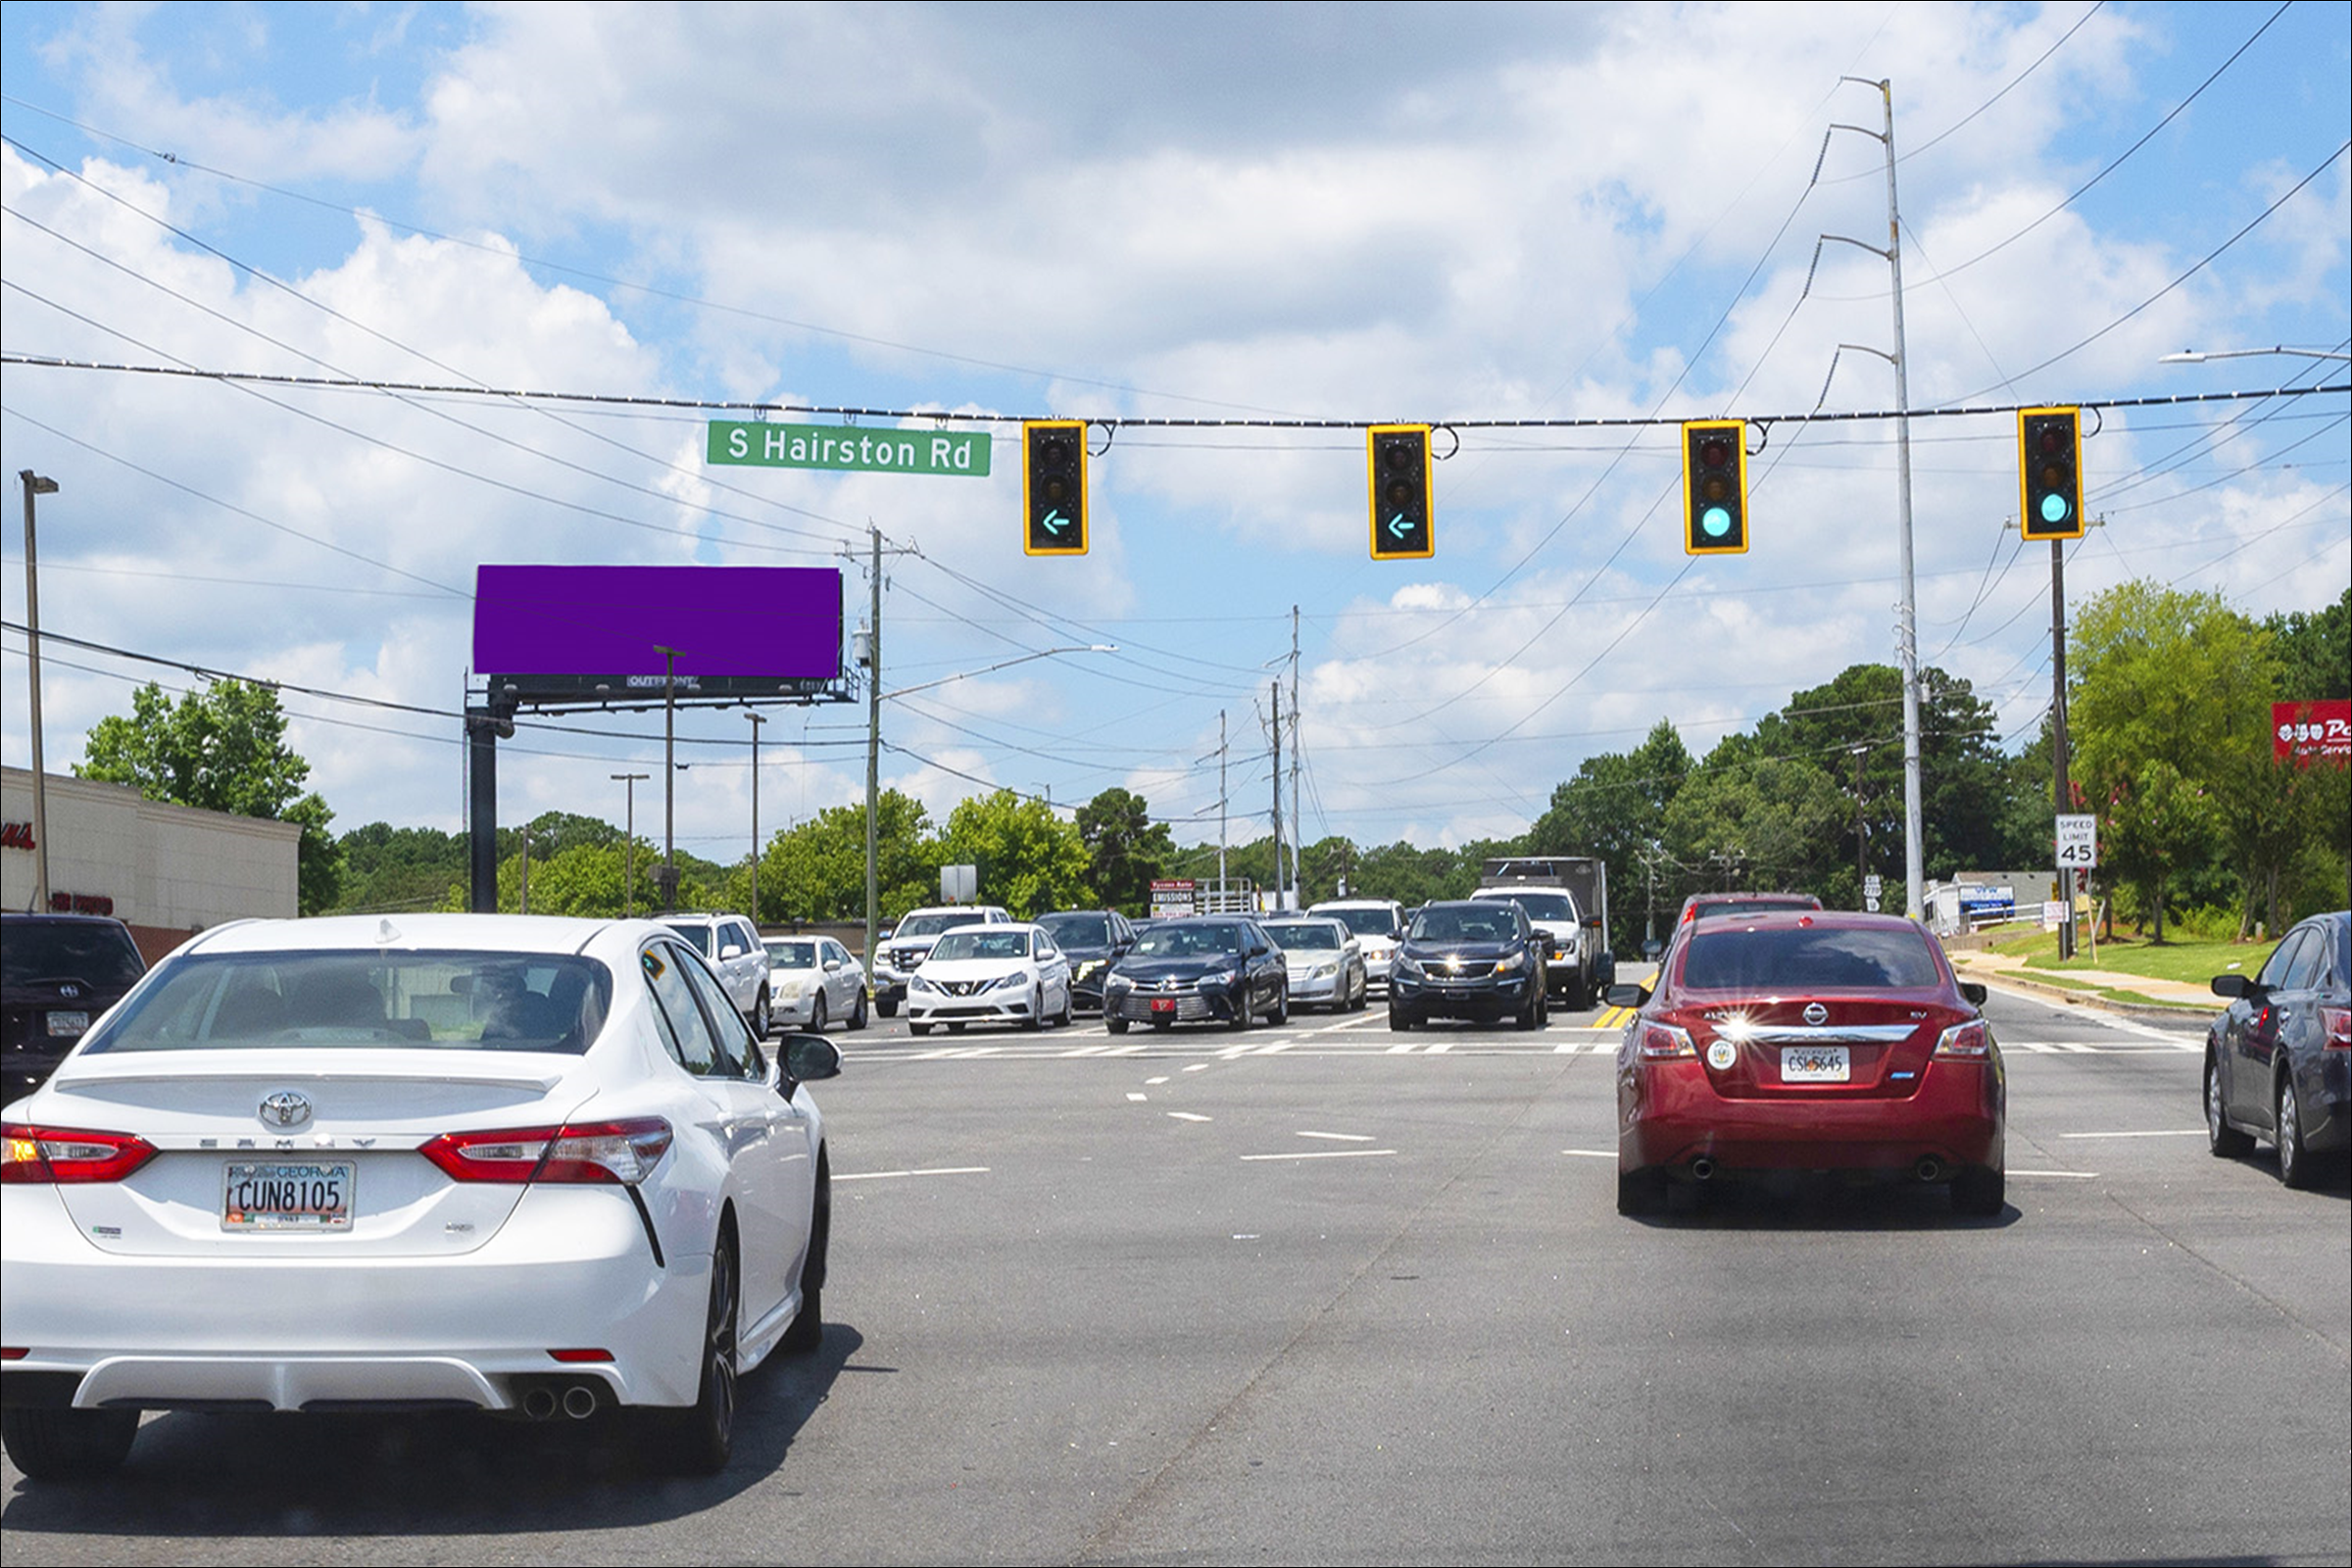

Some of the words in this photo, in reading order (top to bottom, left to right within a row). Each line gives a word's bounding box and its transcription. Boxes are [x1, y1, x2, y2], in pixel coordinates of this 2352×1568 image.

[728, 428, 749, 458] S
[763, 429, 915, 466] Hairston
[931, 438, 970, 468] Rd
[2061, 845, 2091, 861] 45
[1152, 892, 1193, 903] EMISSIONS
[276, 1166, 347, 1178] GEORGIA
[238, 1180, 339, 1212] CUN8105
